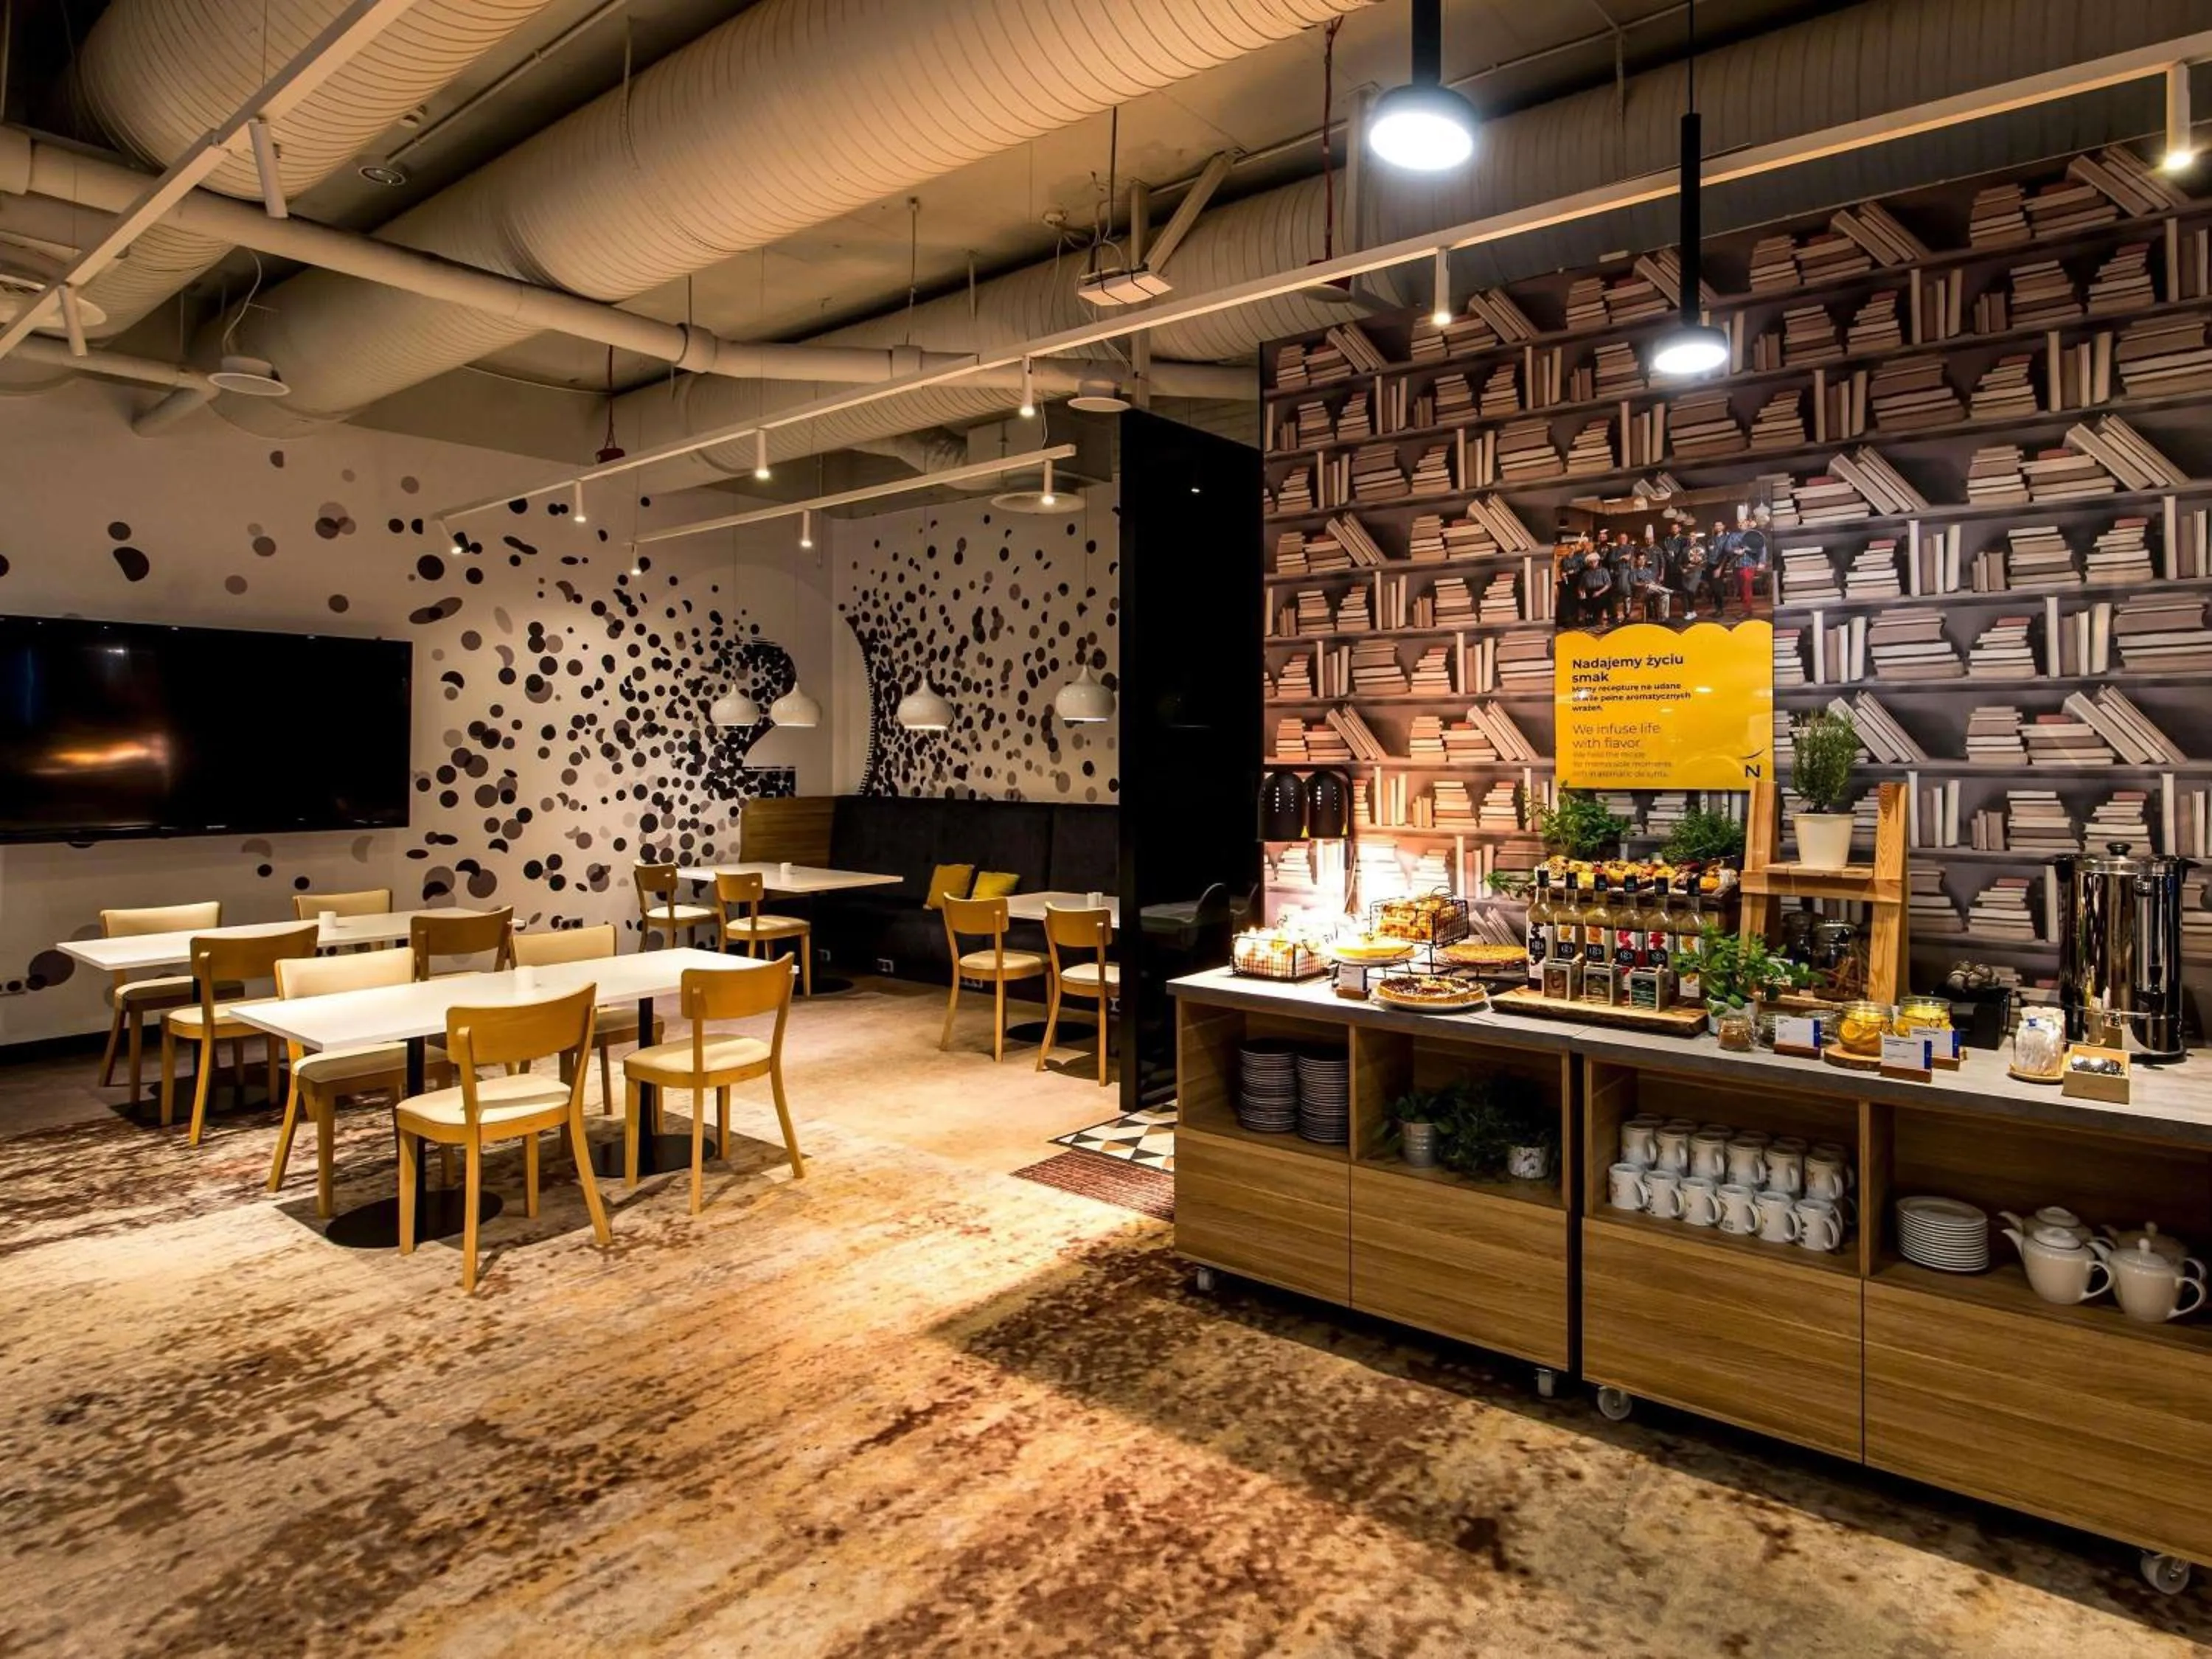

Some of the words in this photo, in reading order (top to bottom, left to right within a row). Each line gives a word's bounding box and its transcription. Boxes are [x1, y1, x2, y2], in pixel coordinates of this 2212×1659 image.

[1572, 656, 1642, 670] Nadajemy
[1646, 653, 1684, 668] życiu
[1571, 672, 1610, 684] smak
[1573, 723, 1593, 735] We
[1596, 723, 1638, 734] infuse
[1641, 722, 1661, 734] life
[1572, 737, 1601, 748] with
[1604, 737, 1641, 748] flavor
[1745, 765, 1760, 778] N
